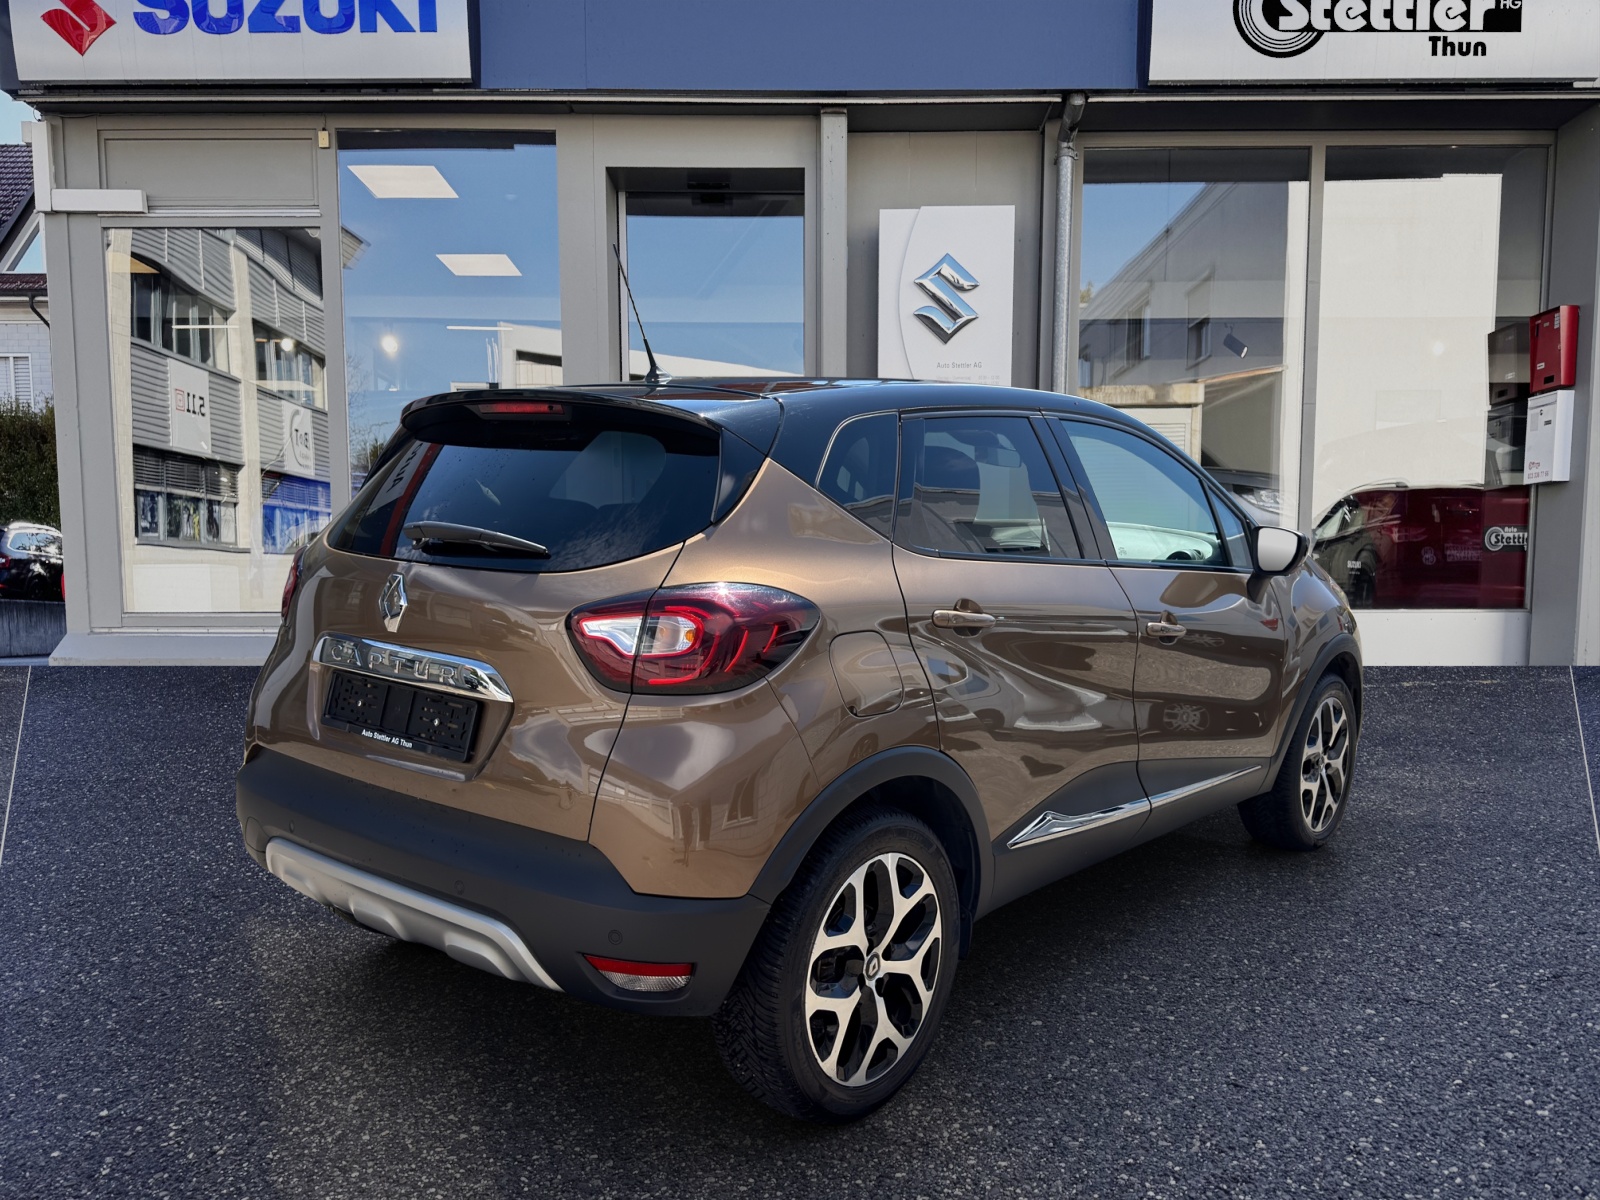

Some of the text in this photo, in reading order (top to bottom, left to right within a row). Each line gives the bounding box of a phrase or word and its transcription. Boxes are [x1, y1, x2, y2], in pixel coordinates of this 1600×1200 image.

[133, 0, 437, 34] SUZUKI
[1279, 0, 1496, 31] Stettler
[1429, 36, 1487, 56] Thun
[973, 361, 982, 369] AG
[1495, 533, 1528, 545] Stettl
[361, 729, 413, 748] Auto Stettler AG Thun
